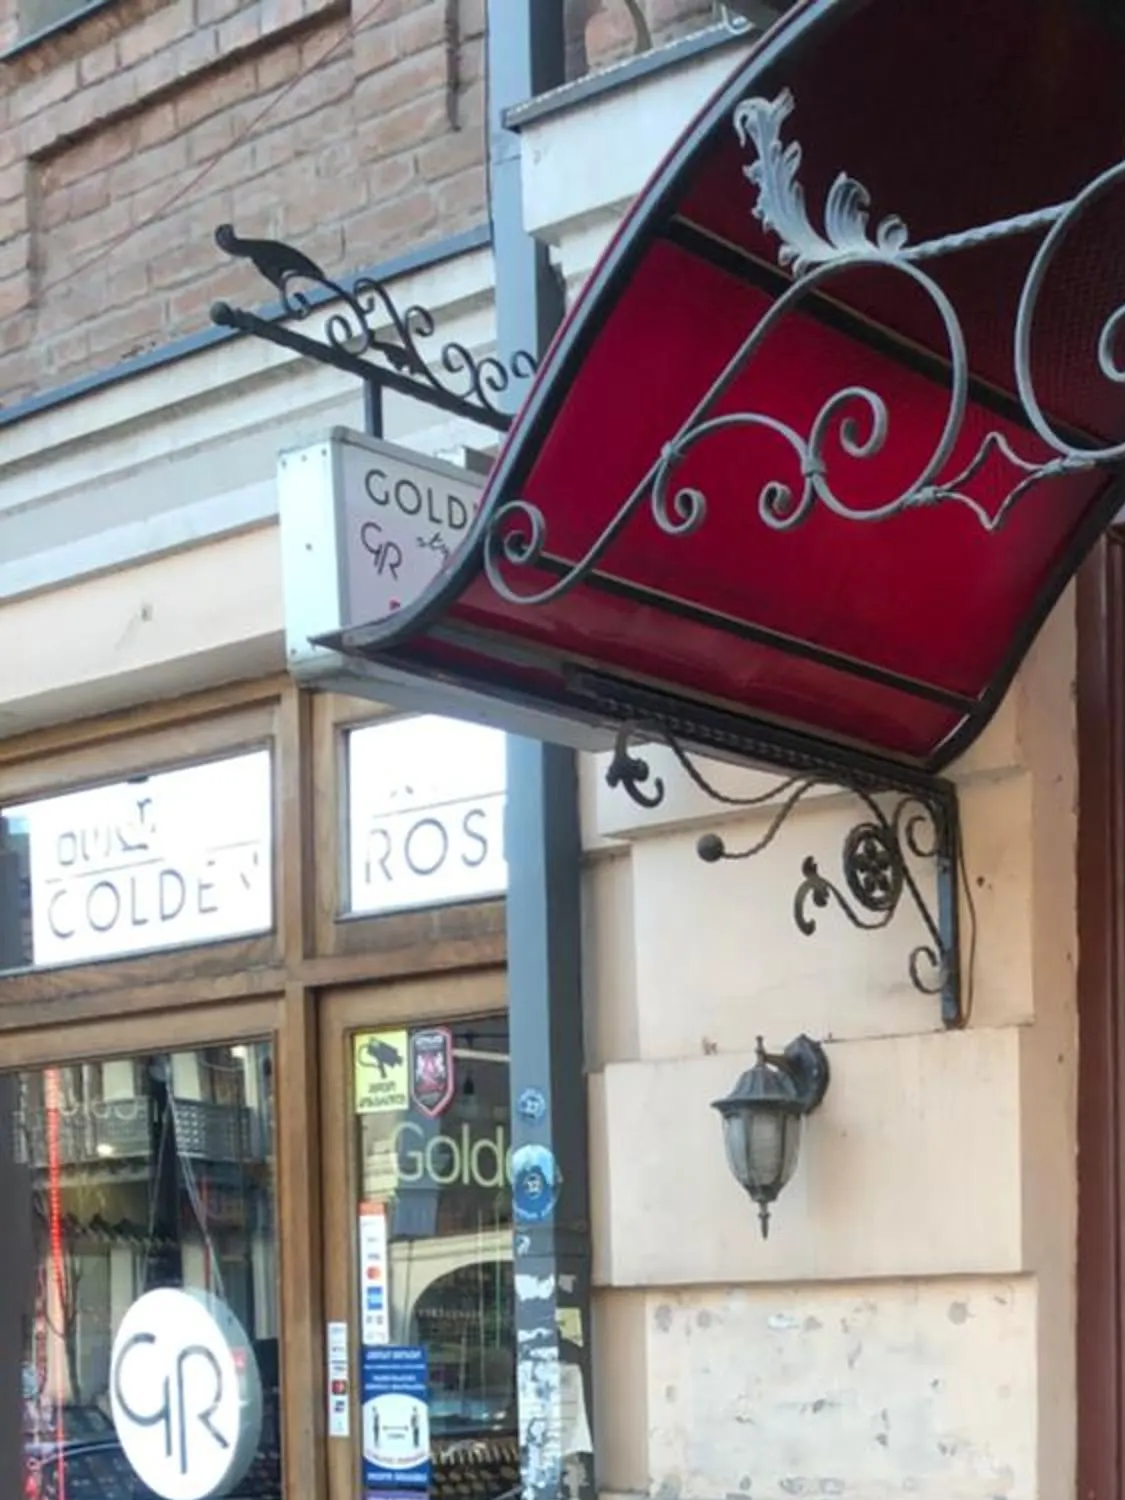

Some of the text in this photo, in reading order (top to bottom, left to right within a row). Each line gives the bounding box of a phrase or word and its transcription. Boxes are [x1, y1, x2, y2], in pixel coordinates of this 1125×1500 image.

[365, 469, 478, 530] GOLD
[365, 808, 506, 886] ROS
[392, 1121, 513, 1188] Gold
